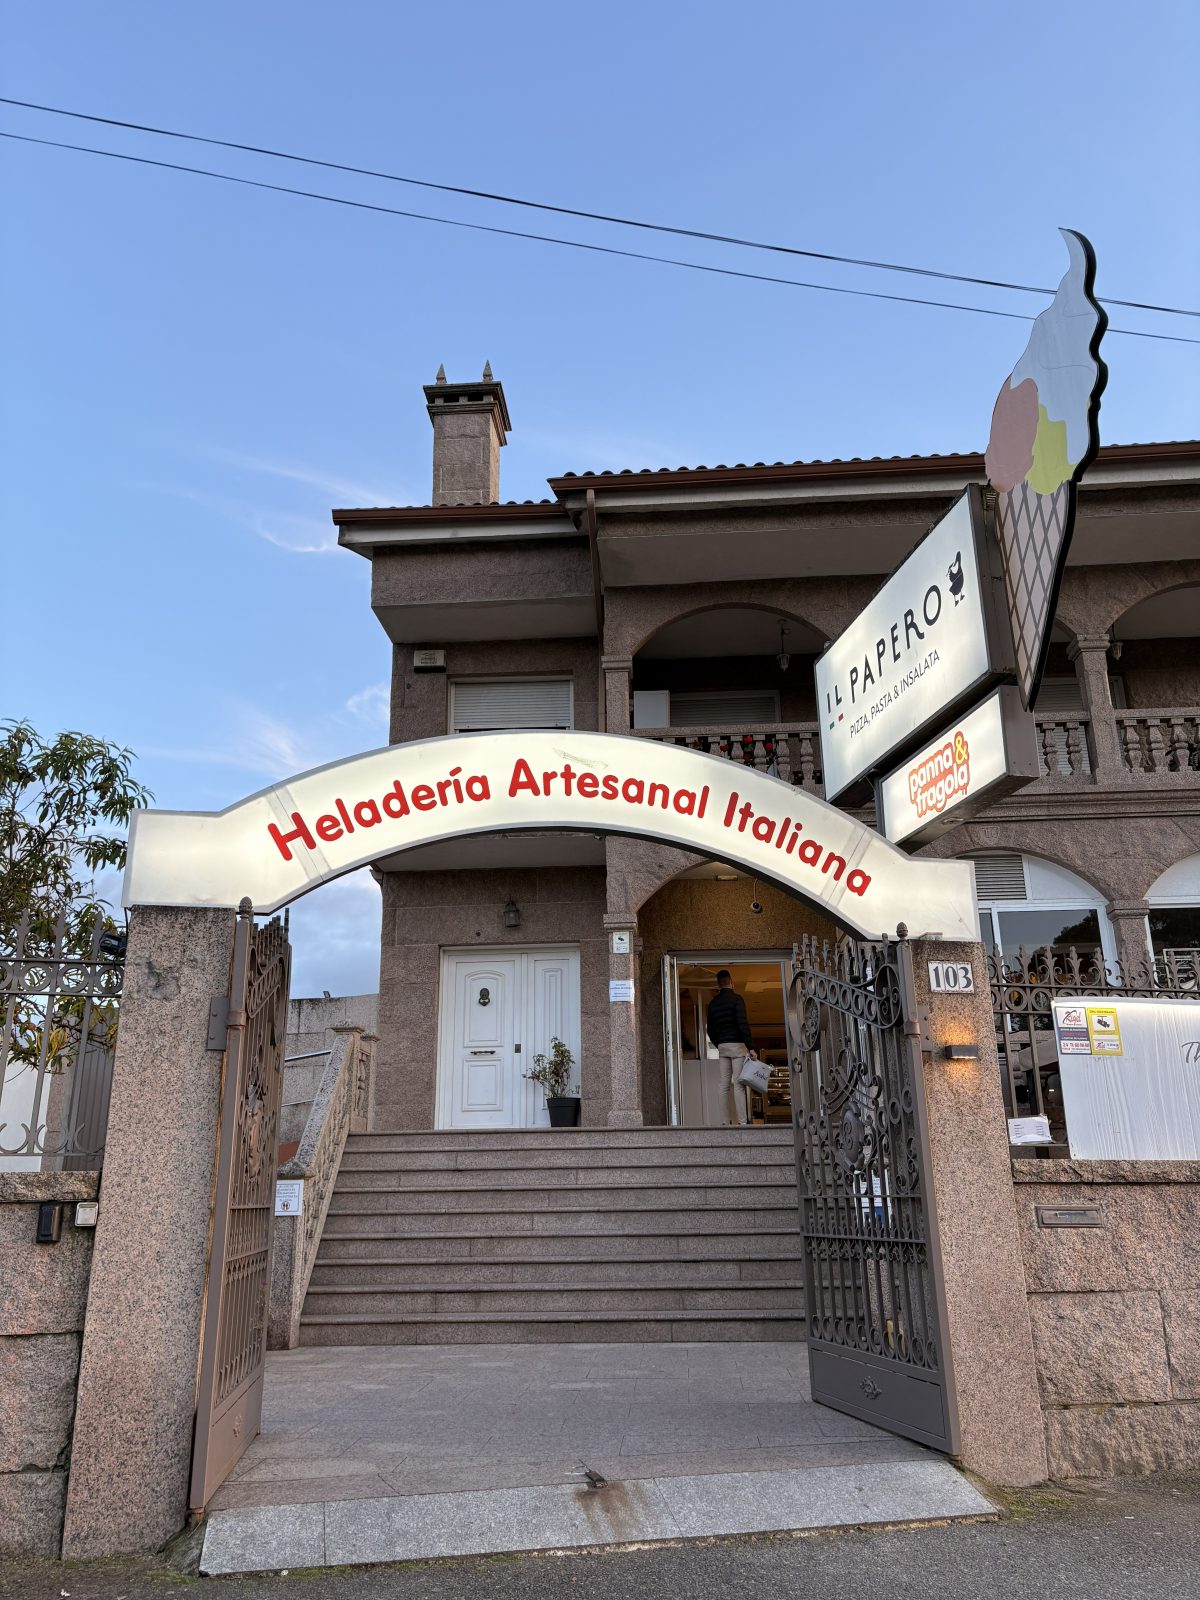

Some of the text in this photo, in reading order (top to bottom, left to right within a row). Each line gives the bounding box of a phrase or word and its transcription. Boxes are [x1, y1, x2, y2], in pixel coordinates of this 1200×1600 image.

[826, 584, 942, 713] IL PAPERO
[850, 649, 940, 738] PIZZA, PASTA & INSALATA
[909, 735, 968, 802] panna &
[916, 762, 969, 816] fragola
[267, 758, 872, 896] Heladería Artesanal Italiana
[933, 965, 972, 989] 103
